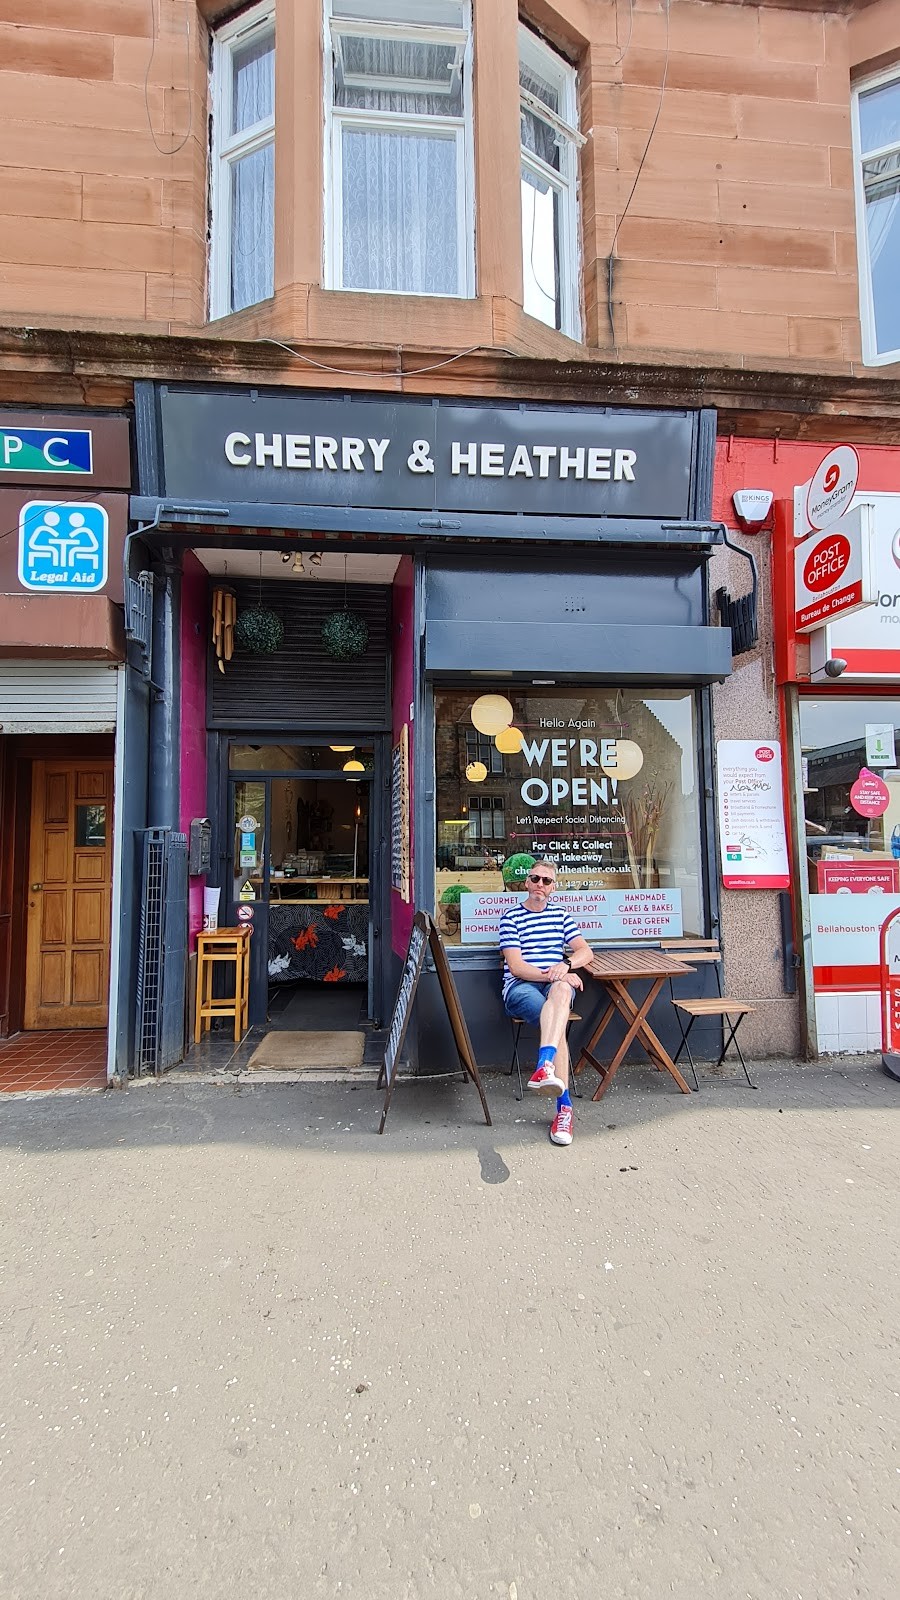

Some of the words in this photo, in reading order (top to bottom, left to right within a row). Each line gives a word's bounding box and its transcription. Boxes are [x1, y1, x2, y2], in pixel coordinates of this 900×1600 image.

[224, 431, 390, 472] CHERRY
[407, 439, 435, 474] &
[451, 442, 637, 481] HEATHER
[811, 480, 854, 516] MoneyGram
[813, 541, 841, 568] POST
[807, 554, 845, 584] OFFICE
[30, 570, 68, 584] Legal
[71, 571, 96, 583] Aid
[800, 608, 821, 622] Bureau
[822, 603, 830, 612] de
[831, 592, 855, 608] Change
[539, 718, 565, 728] Hello
[567, 718, 596, 730] Again
[520, 738, 618, 767] WE'RE
[520, 777, 618, 806] OPEN!
[533, 815, 563, 825] Respect
[565, 815, 587, 824] Social
[589, 815, 626, 825] Distancing
[532, 841, 546, 850] For
[548, 841, 570, 850] Click
[572, 841, 579, 850] &
[582, 840, 613, 850] Collect
[543, 853, 559, 861] And
[562, 853, 603, 863] Takeaway
[566, 880, 581, 888] 427
[583, 879, 604, 887] 0272
[478, 896, 519, 905] GOURMET
[624, 893, 666, 901] HANDMADE
[618, 904, 641, 912] CAKES
[622, 917, 642, 925] DEAR
[644, 917, 670, 925] GREEN
[465, 924, 500, 932] HOMEMA
[817, 925, 876, 933] Bellahouston
